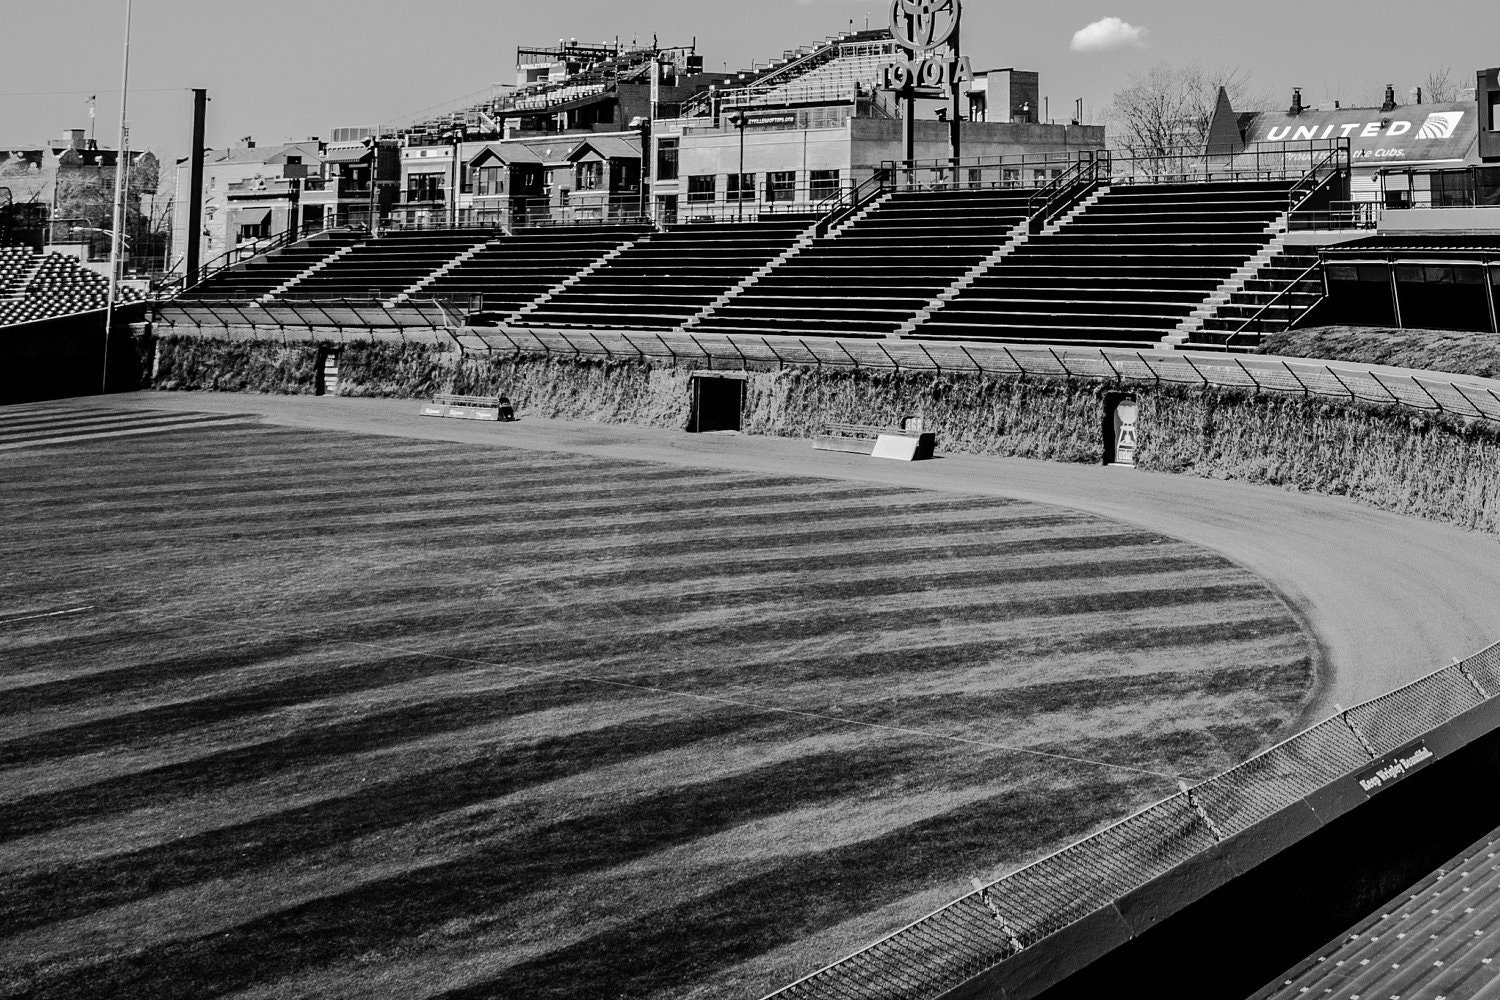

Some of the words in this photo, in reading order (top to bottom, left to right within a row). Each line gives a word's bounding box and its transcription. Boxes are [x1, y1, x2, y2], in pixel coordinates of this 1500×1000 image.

[877, 56, 975, 90] TOYOTA
[1267, 120, 1411, 142] UNITED
[1359, 776, 1382, 791] Keep
[1375, 763, 1405, 781] Wrigley
